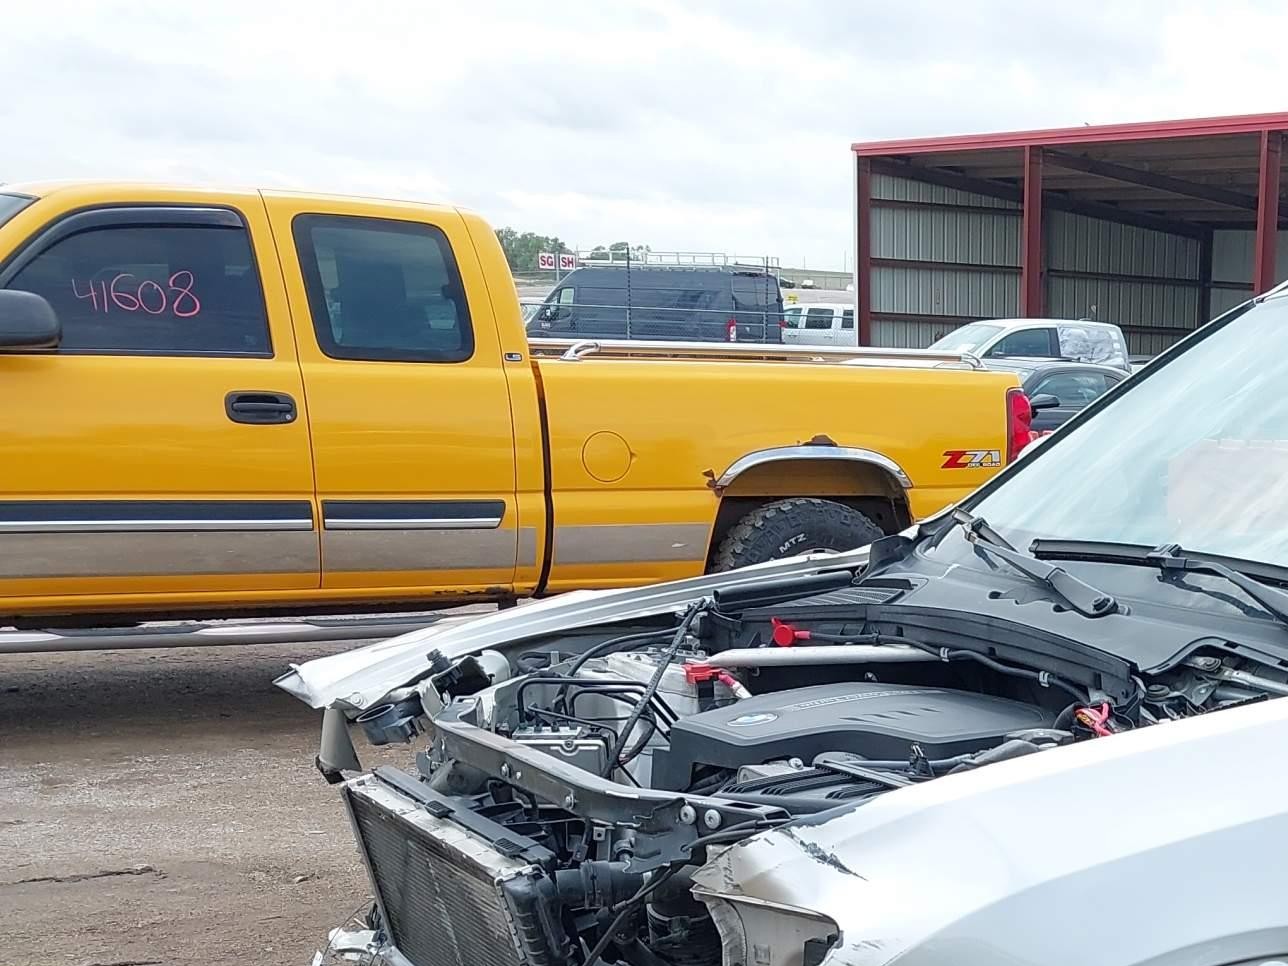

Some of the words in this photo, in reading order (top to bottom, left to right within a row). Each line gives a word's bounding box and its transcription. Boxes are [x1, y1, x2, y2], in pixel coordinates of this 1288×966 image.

[540, 256, 553, 266] SG
[561, 257, 574, 268] SH
[72, 271, 200, 317] 41608
[941, 450, 1001, 469] Z71
